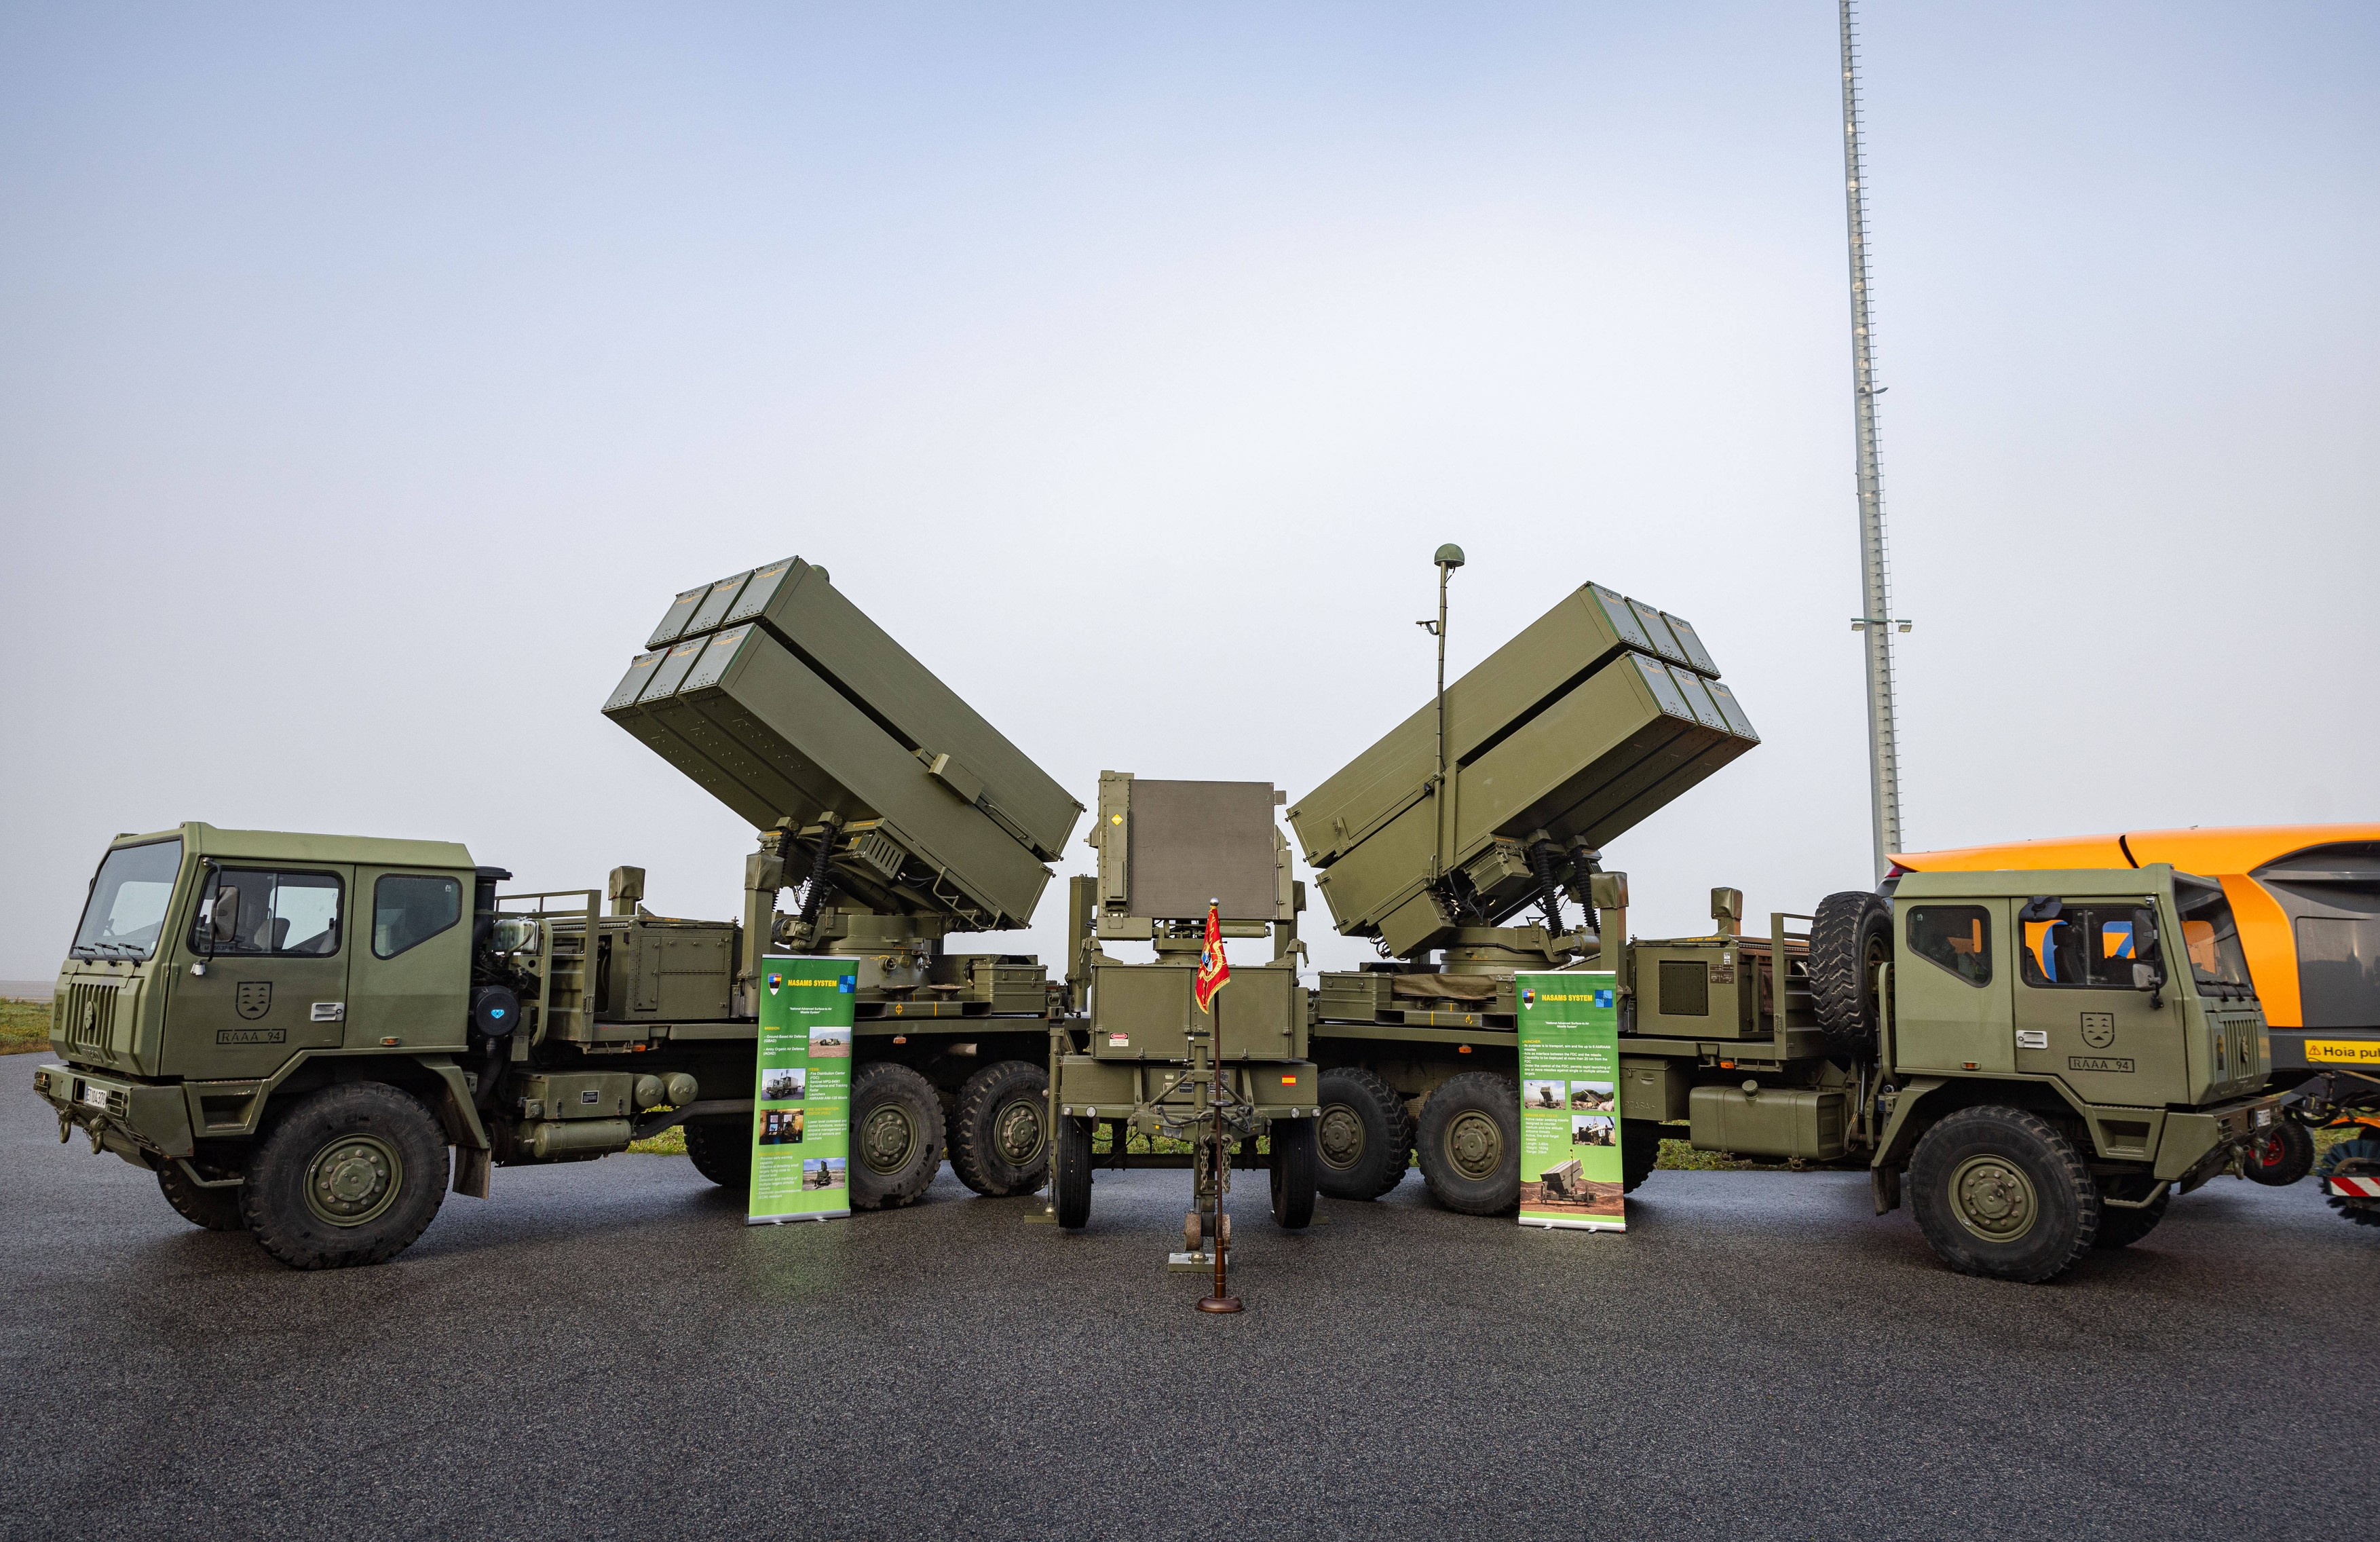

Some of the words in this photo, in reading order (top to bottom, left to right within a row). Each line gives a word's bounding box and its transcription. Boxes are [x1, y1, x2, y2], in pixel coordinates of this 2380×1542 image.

[222, 1032, 259, 1042] RAAA
[267, 1032, 281, 1041] 94
[2324, 1047, 2356, 1057] Hoia
[2074, 1059, 2109, 1069] RAAA
[2116, 1061, 2129, 1070] 94
